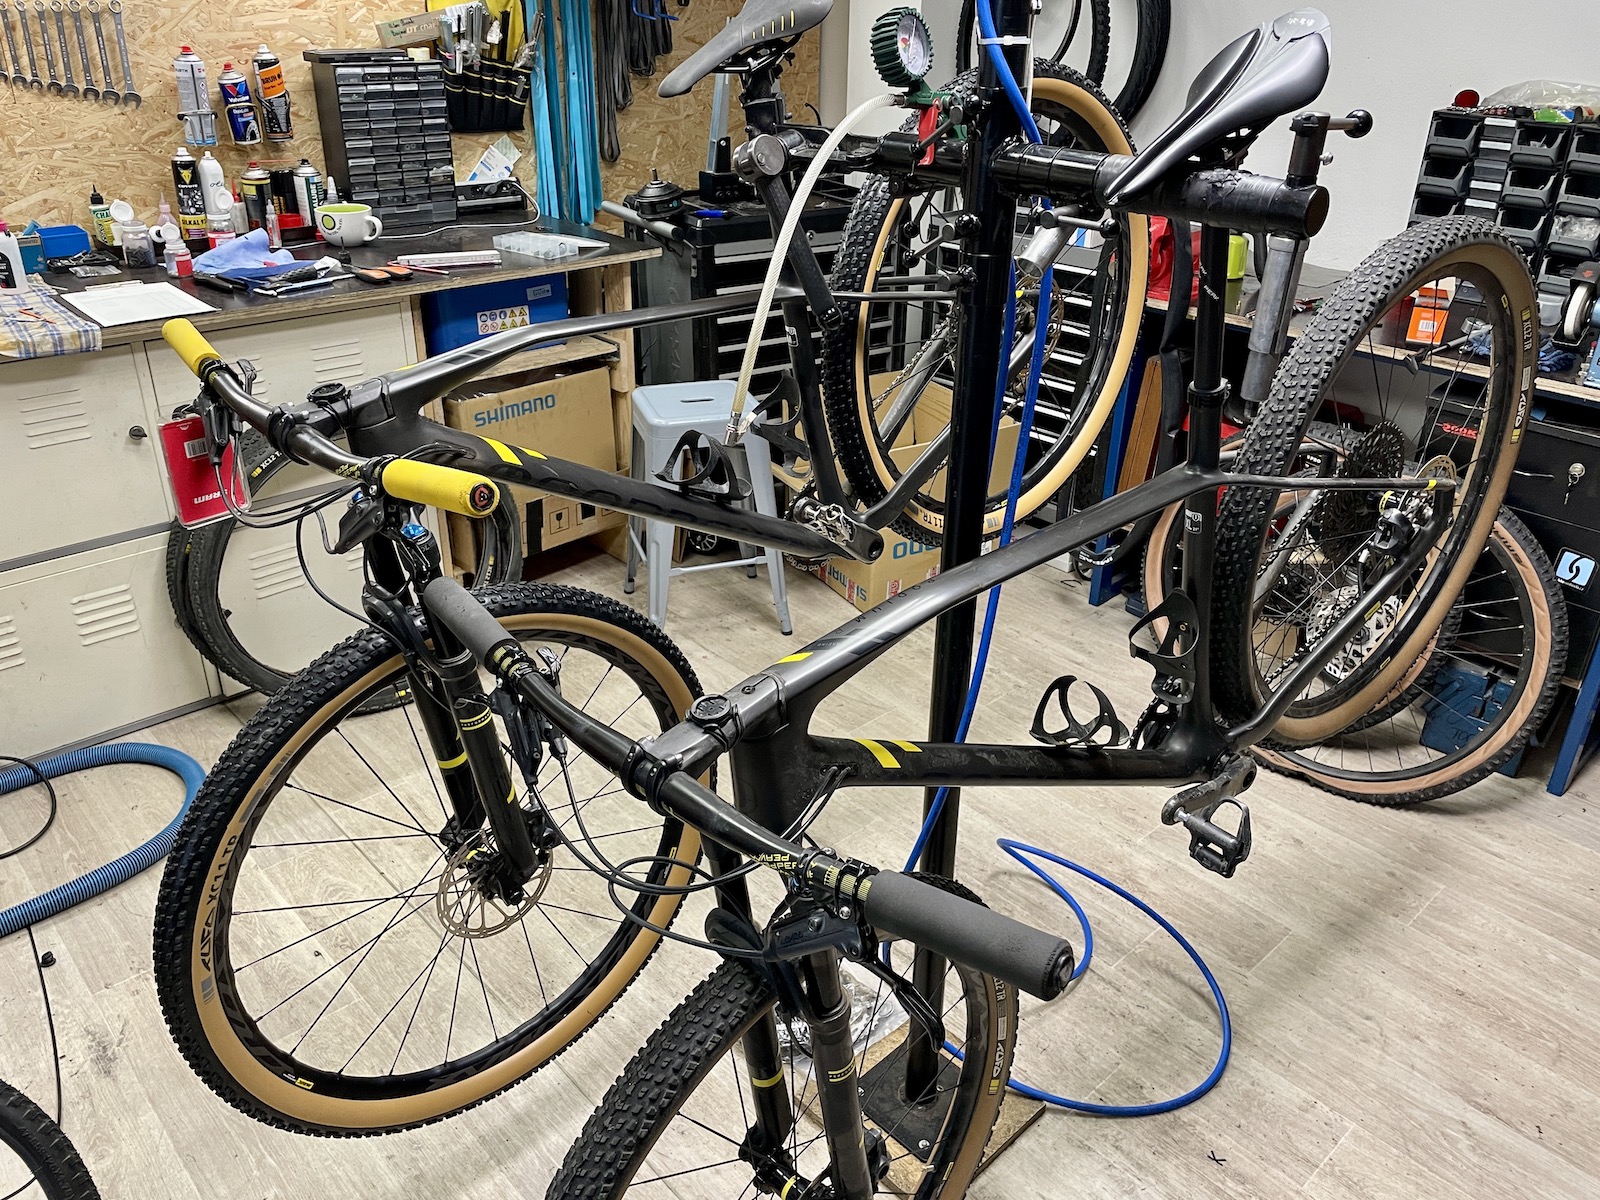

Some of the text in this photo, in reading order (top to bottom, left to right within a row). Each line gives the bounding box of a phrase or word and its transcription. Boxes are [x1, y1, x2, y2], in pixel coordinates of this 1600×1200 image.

[474, 394, 556, 428] SHIMANO
[1514, 393, 1527, 428] TUFO
[260, 454, 277, 470] XC12
[207, 863, 227, 905] XC11
[993, 1042, 1005, 1078] TUFO
